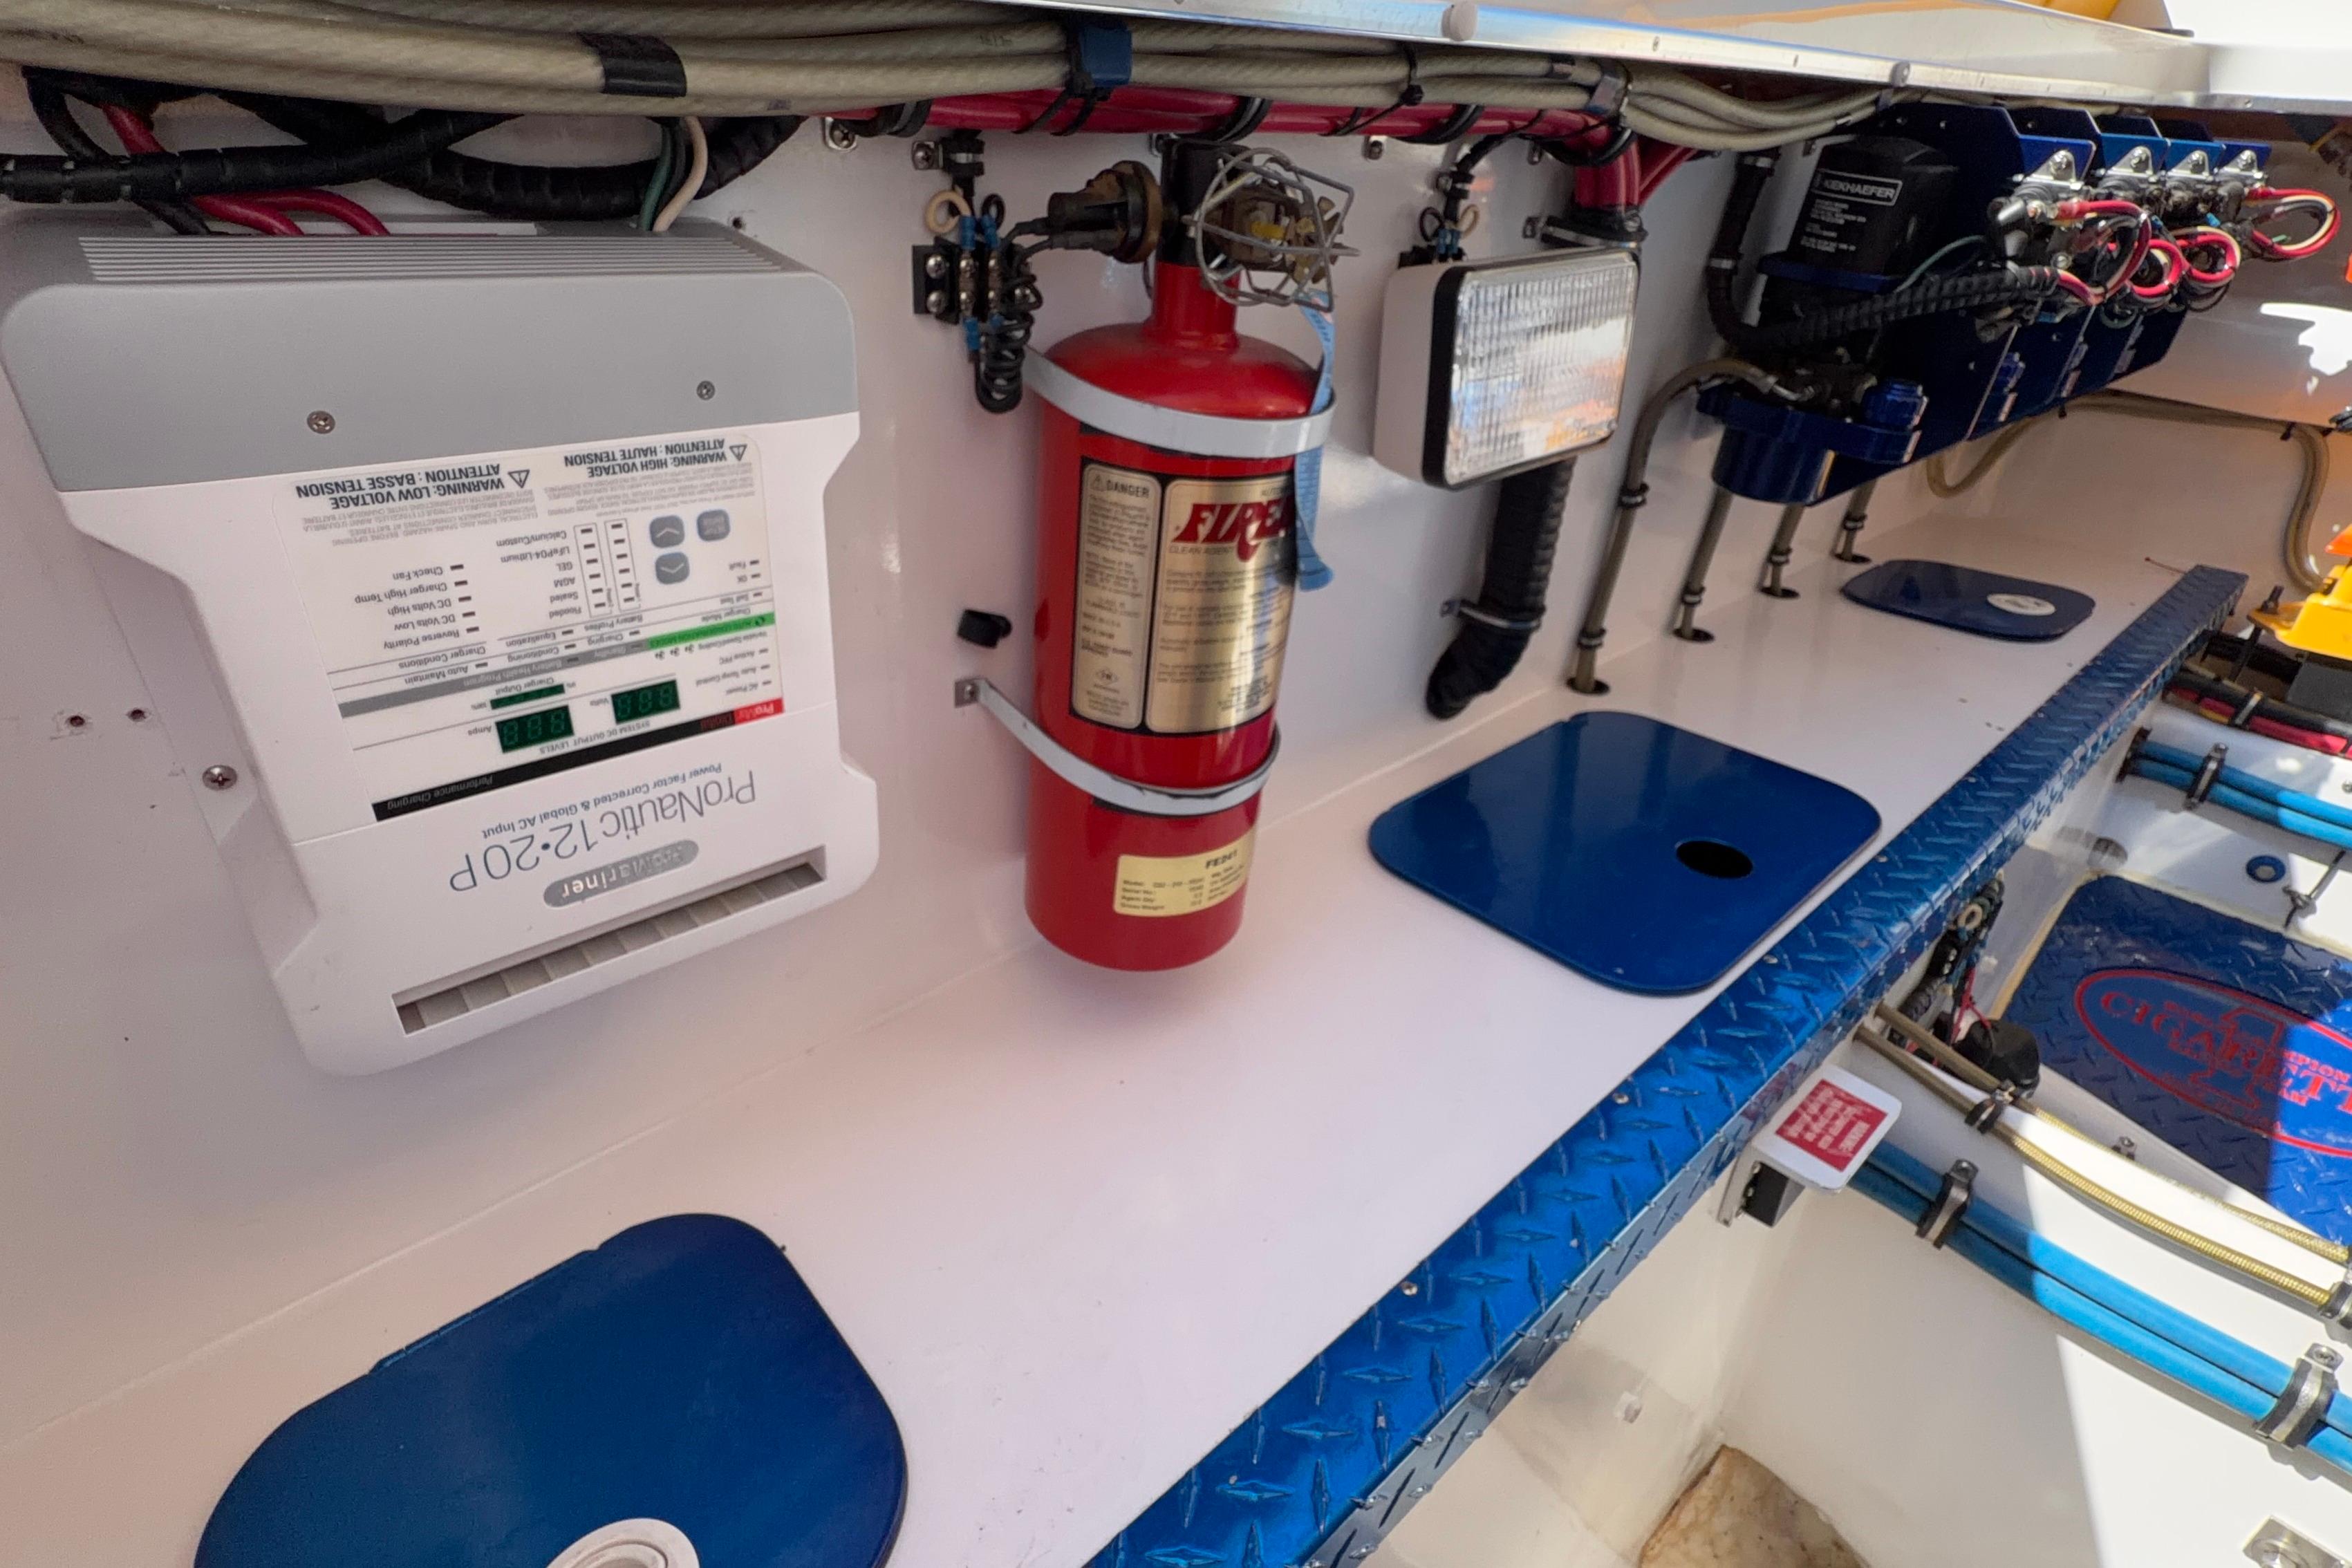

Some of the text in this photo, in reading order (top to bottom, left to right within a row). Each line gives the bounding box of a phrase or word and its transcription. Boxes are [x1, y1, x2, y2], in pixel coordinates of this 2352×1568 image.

[619, 445, 657, 460] HAUTE
[664, 438, 725, 455] ATTENTION
[563, 449, 617, 467] TENSION
[640, 458, 669, 474] HIGH
[671, 451, 727, 467] WARNING:
[424, 463, 501, 483] ATTENTION
[586, 460, 638, 478] VOLTAGE
[295, 478, 363, 498] TENSION
[366, 473, 415, 491] BASSE
[432, 478, 504, 496] WARNING:
[1106, 480, 1150, 498] DANGER
[329, 490, 395, 510] VOLTAGE
[398, 485, 431, 501] LOW
[1172, 496, 1295, 562] FIRE
[496, 530, 567, 548] Calcium/Custom
[393, 566, 443, 581] Check Fan
[556, 561, 572, 572] GEL
[554, 577, 575, 588] AGM
[355, 581, 447, 605] Charger High Temp
[550, 592, 578, 604] Sealed
[387, 598, 451, 617] DC Volts High
[549, 606, 581, 619] Flooded
[394, 614, 456, 632] DC Volts Low
[383, 629, 460, 651] Reverse Polarity
[506, 631, 556, 647] Equalization
[588, 633, 624, 646] Charging
[398, 646, 486, 669] Charger Conditions
[507, 646, 559, 663] Conditioning
[404, 665, 469, 685] Auto Maintain
[496, 677, 554, 695] Charger Output
[468, 726, 492, 736] Amps
[573, 732, 604, 746] OUTPUT
[539, 741, 569, 754] LEVELS
[387, 775, 493, 810] Performance Charging
[482, 763, 722, 839] Power Factor Corrected & Global AC Input
